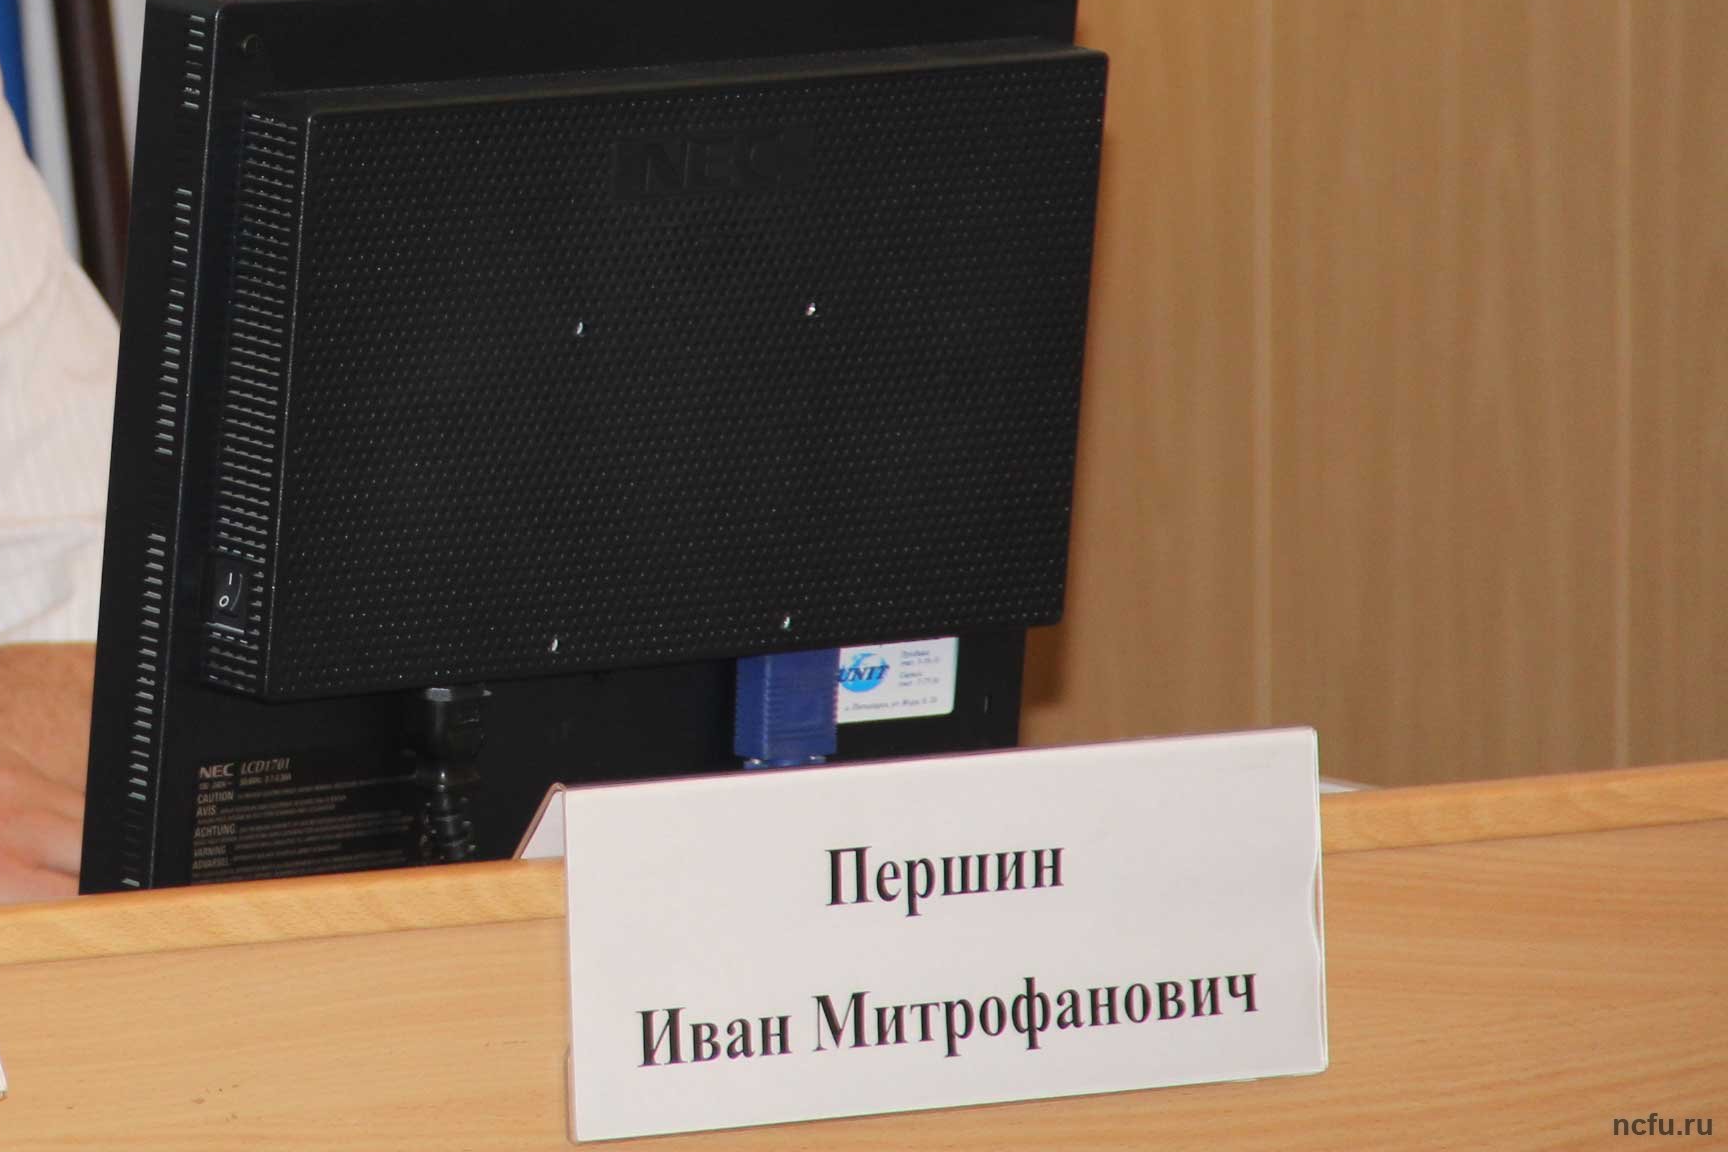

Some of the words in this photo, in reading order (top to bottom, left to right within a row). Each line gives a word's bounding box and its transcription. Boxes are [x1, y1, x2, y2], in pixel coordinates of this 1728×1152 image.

[642, 131, 784, 194] NEC
[199, 762, 234, 778] NEC
[197, 790, 234, 805] CAUTION
[193, 823, 236, 838] ACHTUNG
[826, 846, 1064, 917] Першин
[636, 1006, 792, 1067] Иван
[813, 973, 1259, 1059] Митрофанович
